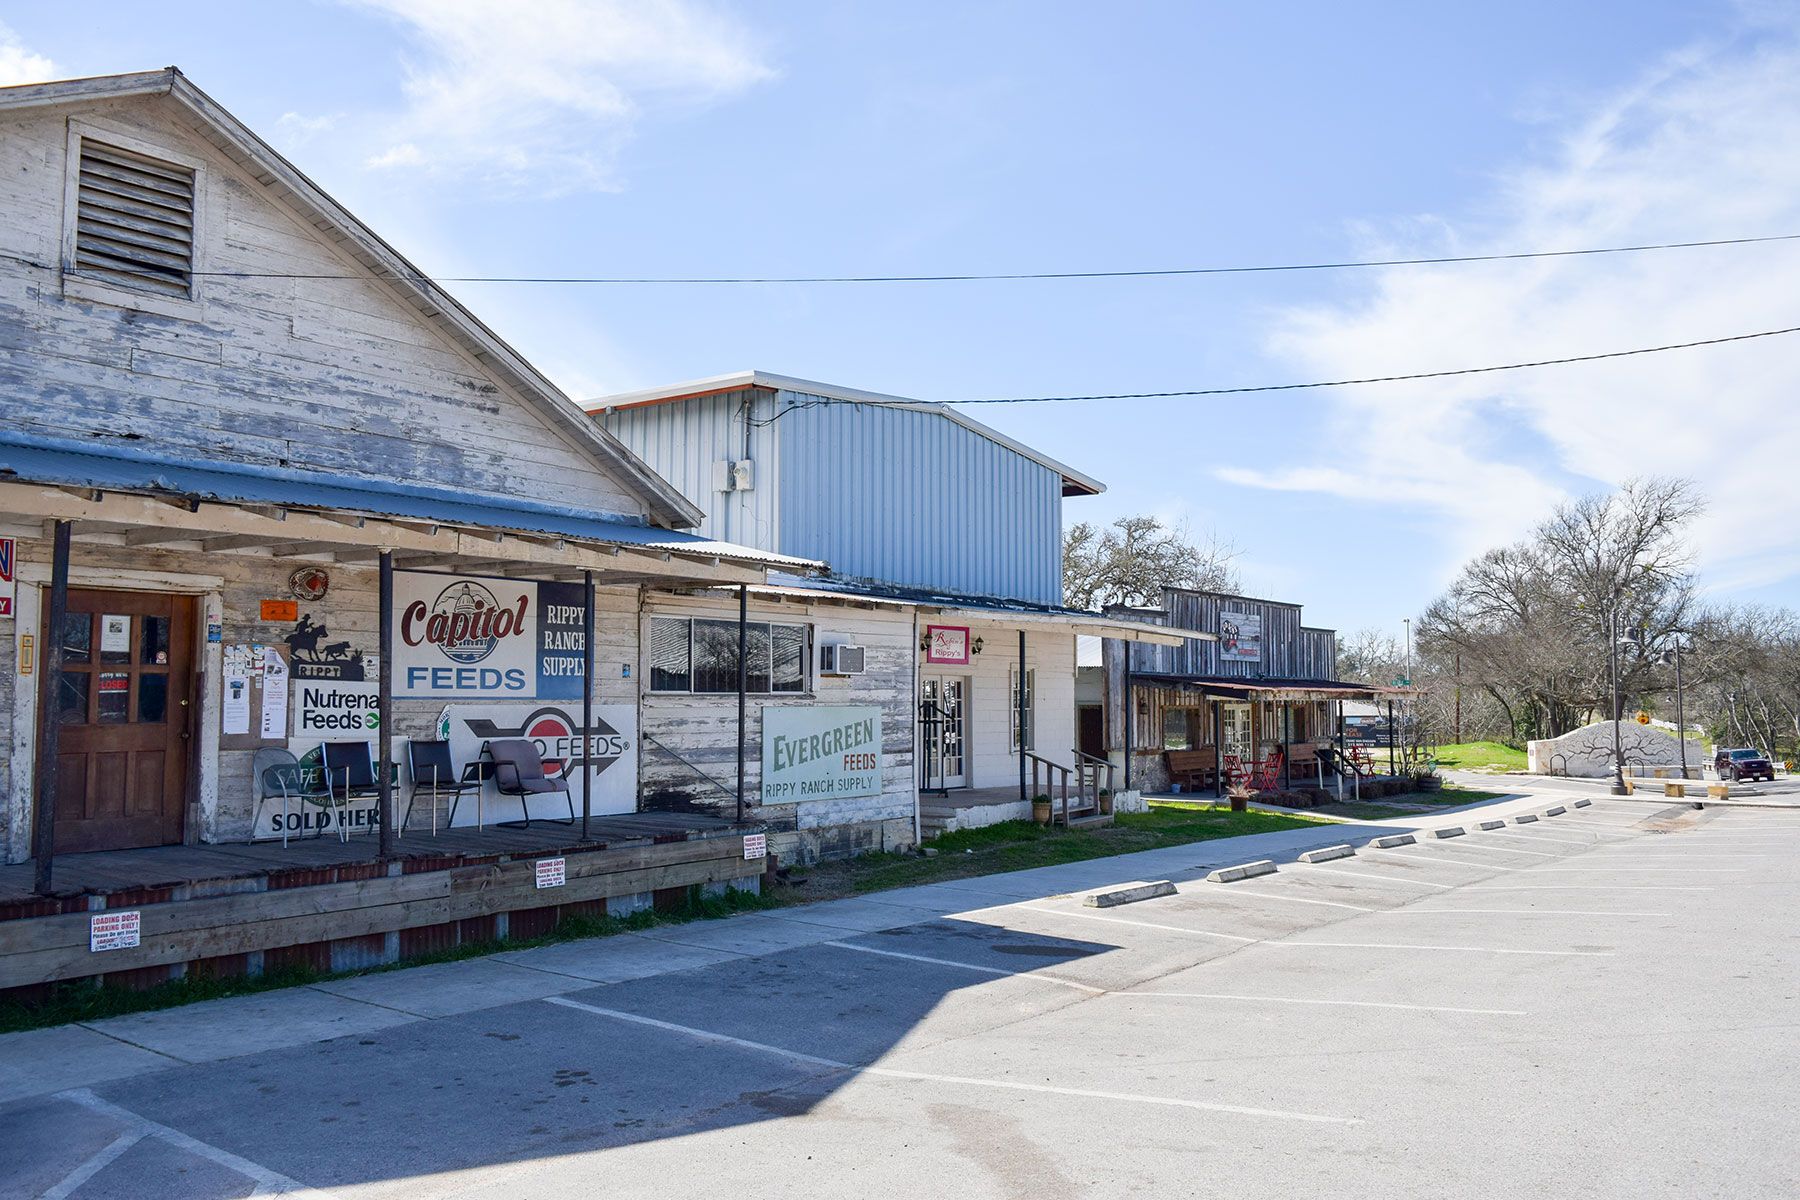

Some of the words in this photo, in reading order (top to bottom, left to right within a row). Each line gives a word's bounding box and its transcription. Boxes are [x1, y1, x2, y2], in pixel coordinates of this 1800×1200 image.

[401, 594, 529, 647] Capitol
[547, 605, 585, 625] RIPPY
[544, 631, 585, 650] RANCH
[300, 666, 340, 677] RIPPY
[407, 666, 526, 690] FEEDS
[99, 681, 128, 689] LOSED
[304, 688, 380, 709] Nutrena
[303, 710, 362, 729] Feeds
[773, 718, 873, 772] EVERGREEN
[844, 753, 876, 771] FEEDS
[765, 782, 796, 798] RIPPY
[801, 779, 834, 795] RANCH
[838, 776, 873, 791] SUPPLY
[272, 811, 331, 832] SOLD
[339, 809, 380, 827] HER
[93, 916, 120, 926] LOADING
[121, 914, 139, 922] DOCK
[93, 924, 120, 933] PARKING
